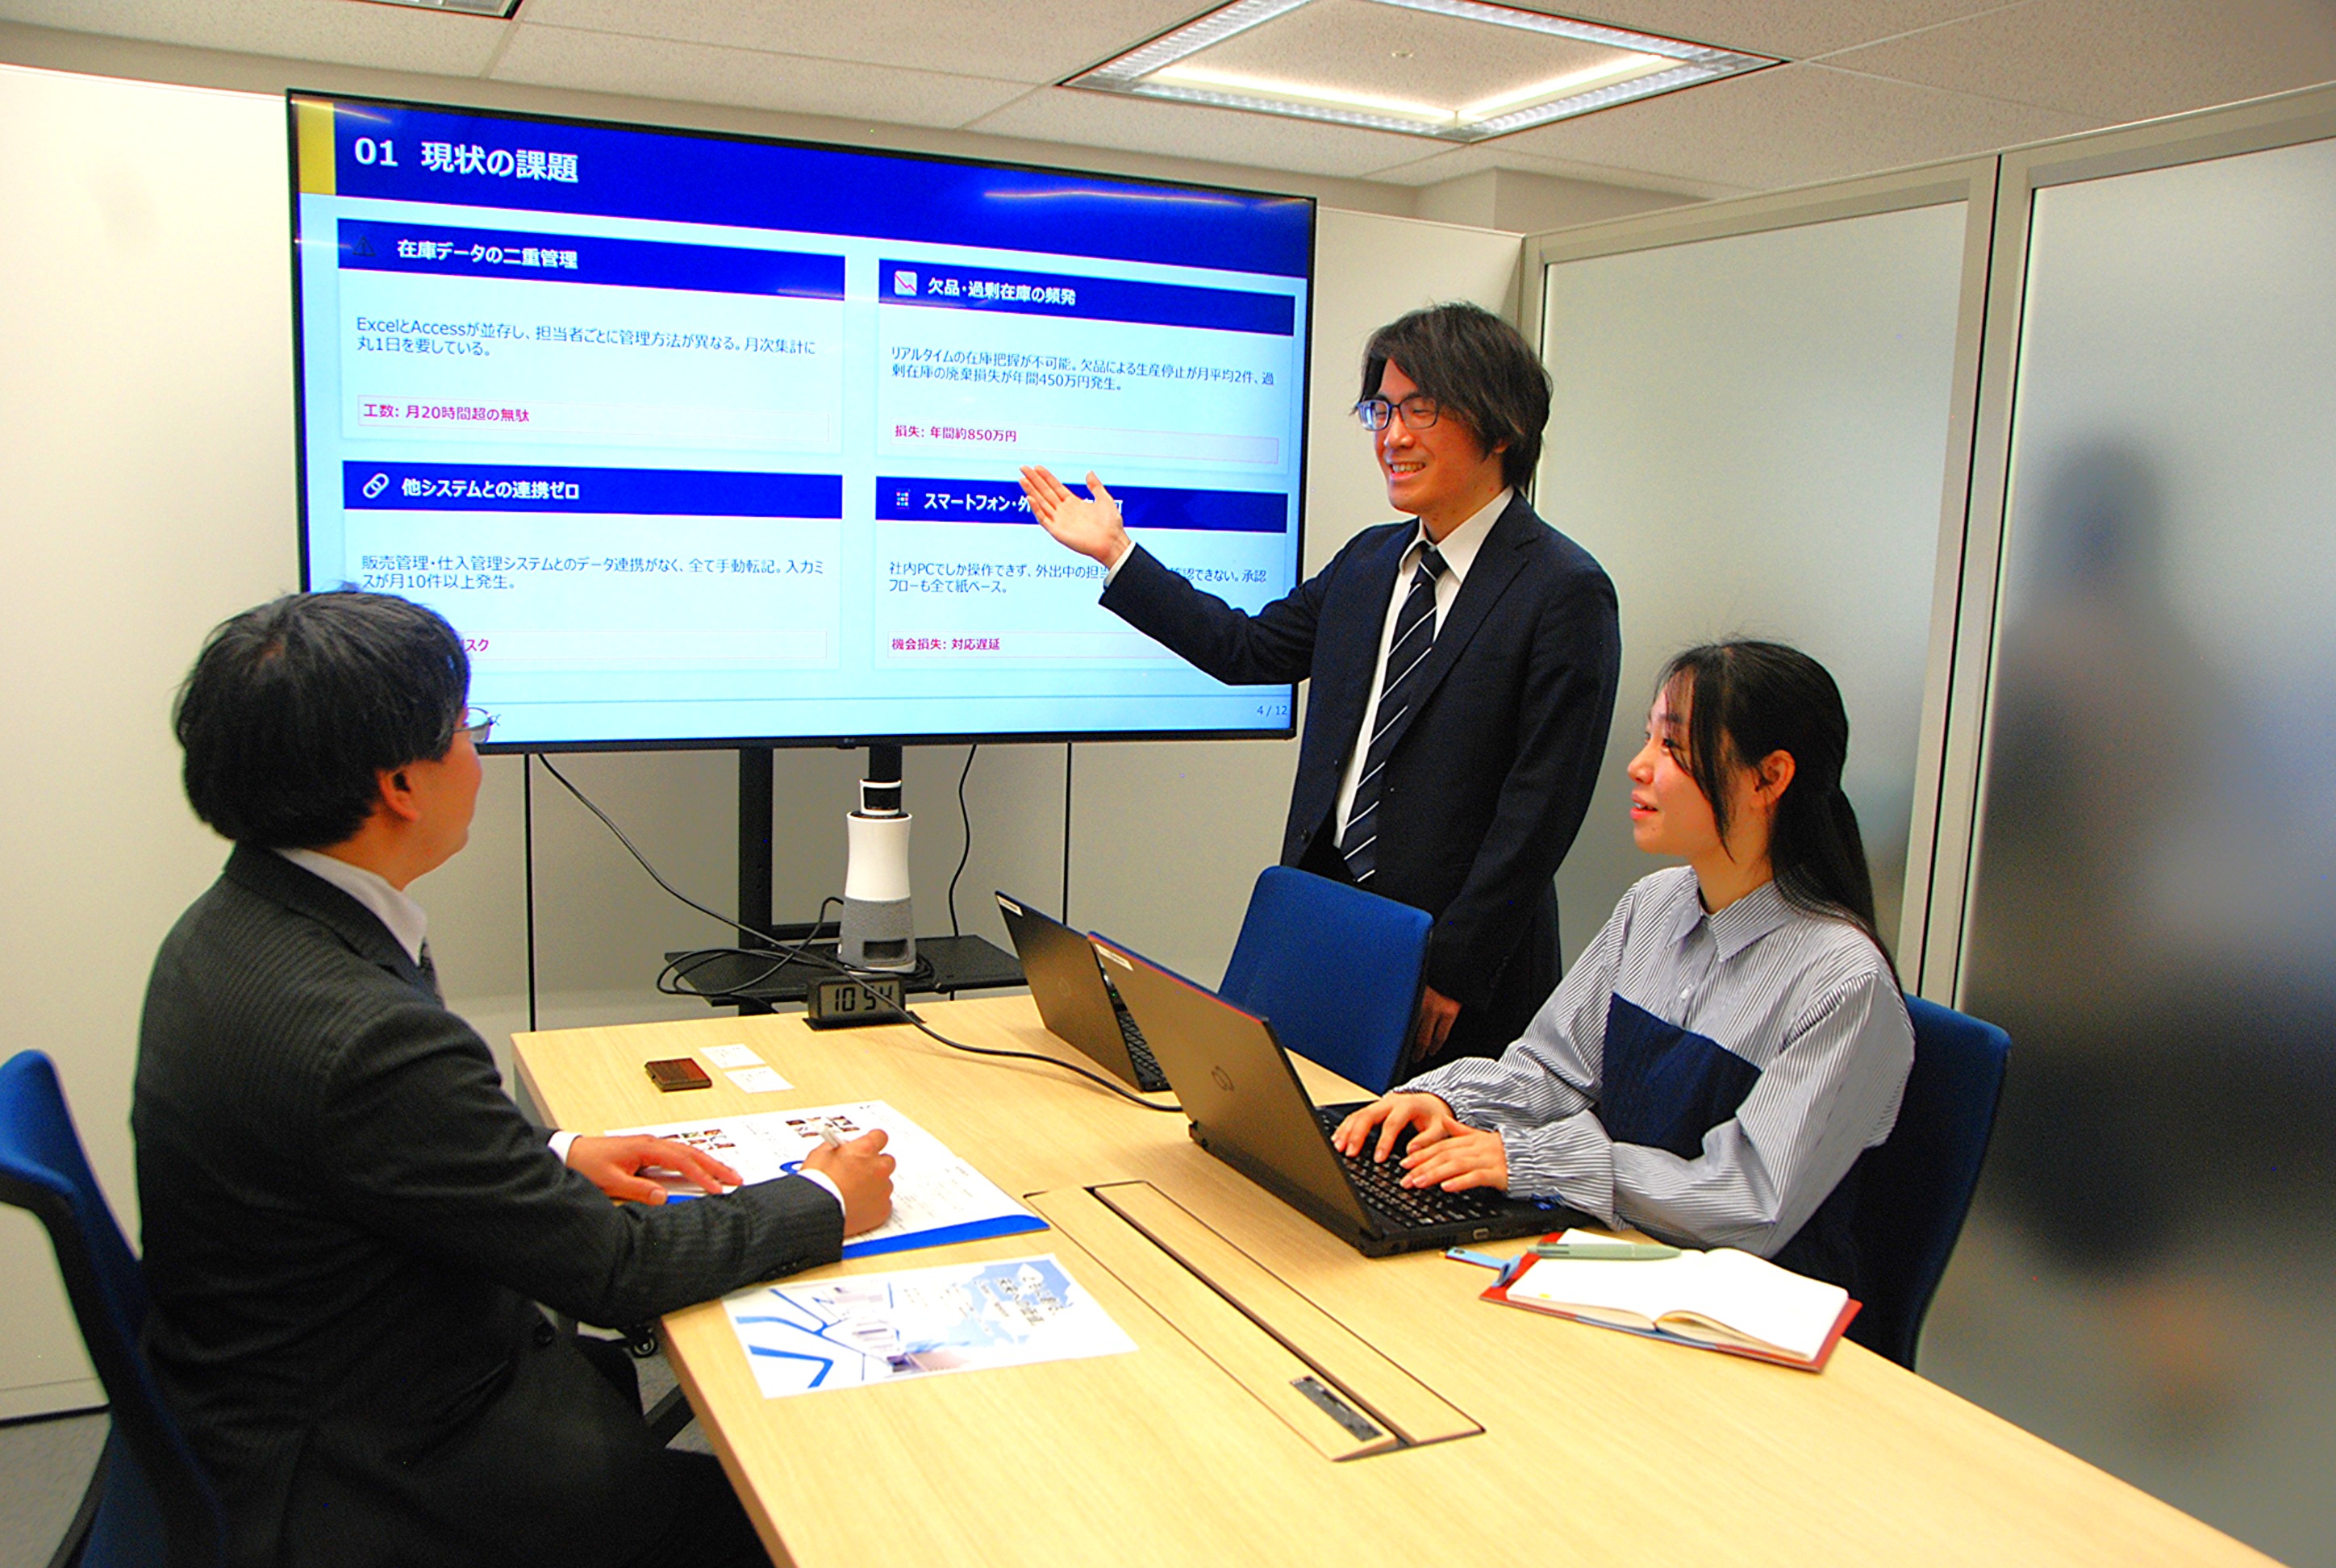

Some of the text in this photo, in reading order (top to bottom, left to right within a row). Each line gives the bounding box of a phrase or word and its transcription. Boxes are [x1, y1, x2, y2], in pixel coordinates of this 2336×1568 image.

[354, 137, 578, 183] 01 現状の課題
[398, 240, 578, 269] 在庫データの二重管理
[928, 277, 1076, 306] 欠品・過剰在庫の頻発
[357, 336, 490, 357] 丸1日を要している。
[406, 404, 530, 423] 月20時間超の無駄
[930, 426, 1017, 443] 年間約850万円
[402, 478, 580, 500] 他システムとの連携ゼロ
[363, 573, 515, 590] スが月10件以上発生。
[889, 578, 1007, 594] フローも全て紙ベース。
[951, 638, 1000, 650] 対応遅延
[1257, 706, 1263, 715] 4
[1275, 706, 1287, 715] 12
